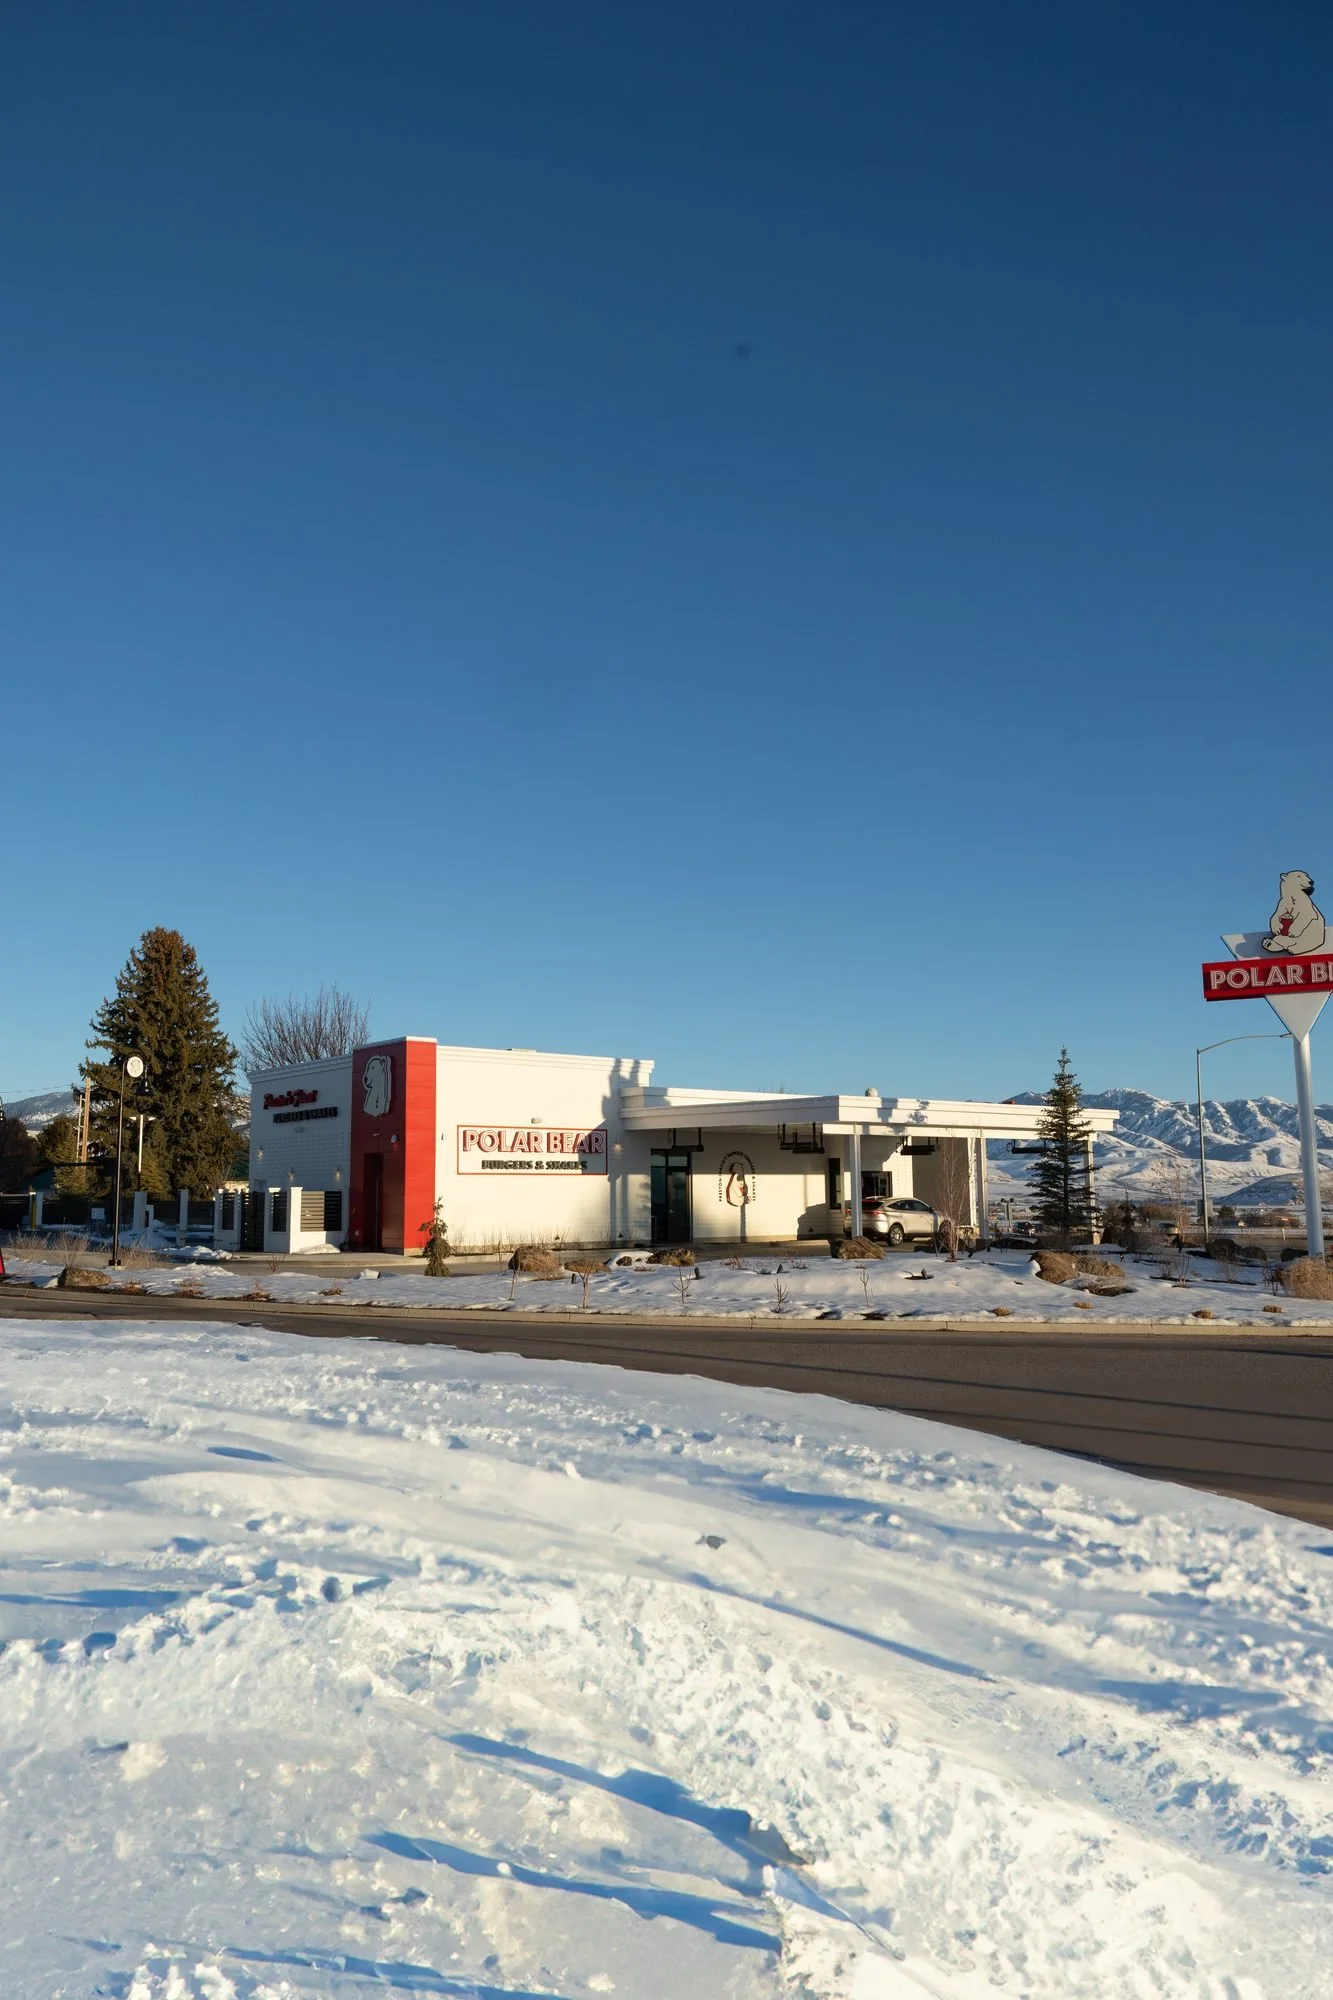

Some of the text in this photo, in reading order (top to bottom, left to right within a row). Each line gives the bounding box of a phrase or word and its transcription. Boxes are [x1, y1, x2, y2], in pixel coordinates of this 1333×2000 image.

[1210, 964, 1304, 990] POLAR
[463, 1130, 604, 1153] POLAR BEAR
[482, 1160, 588, 1170] BURGERS & SHAKES
